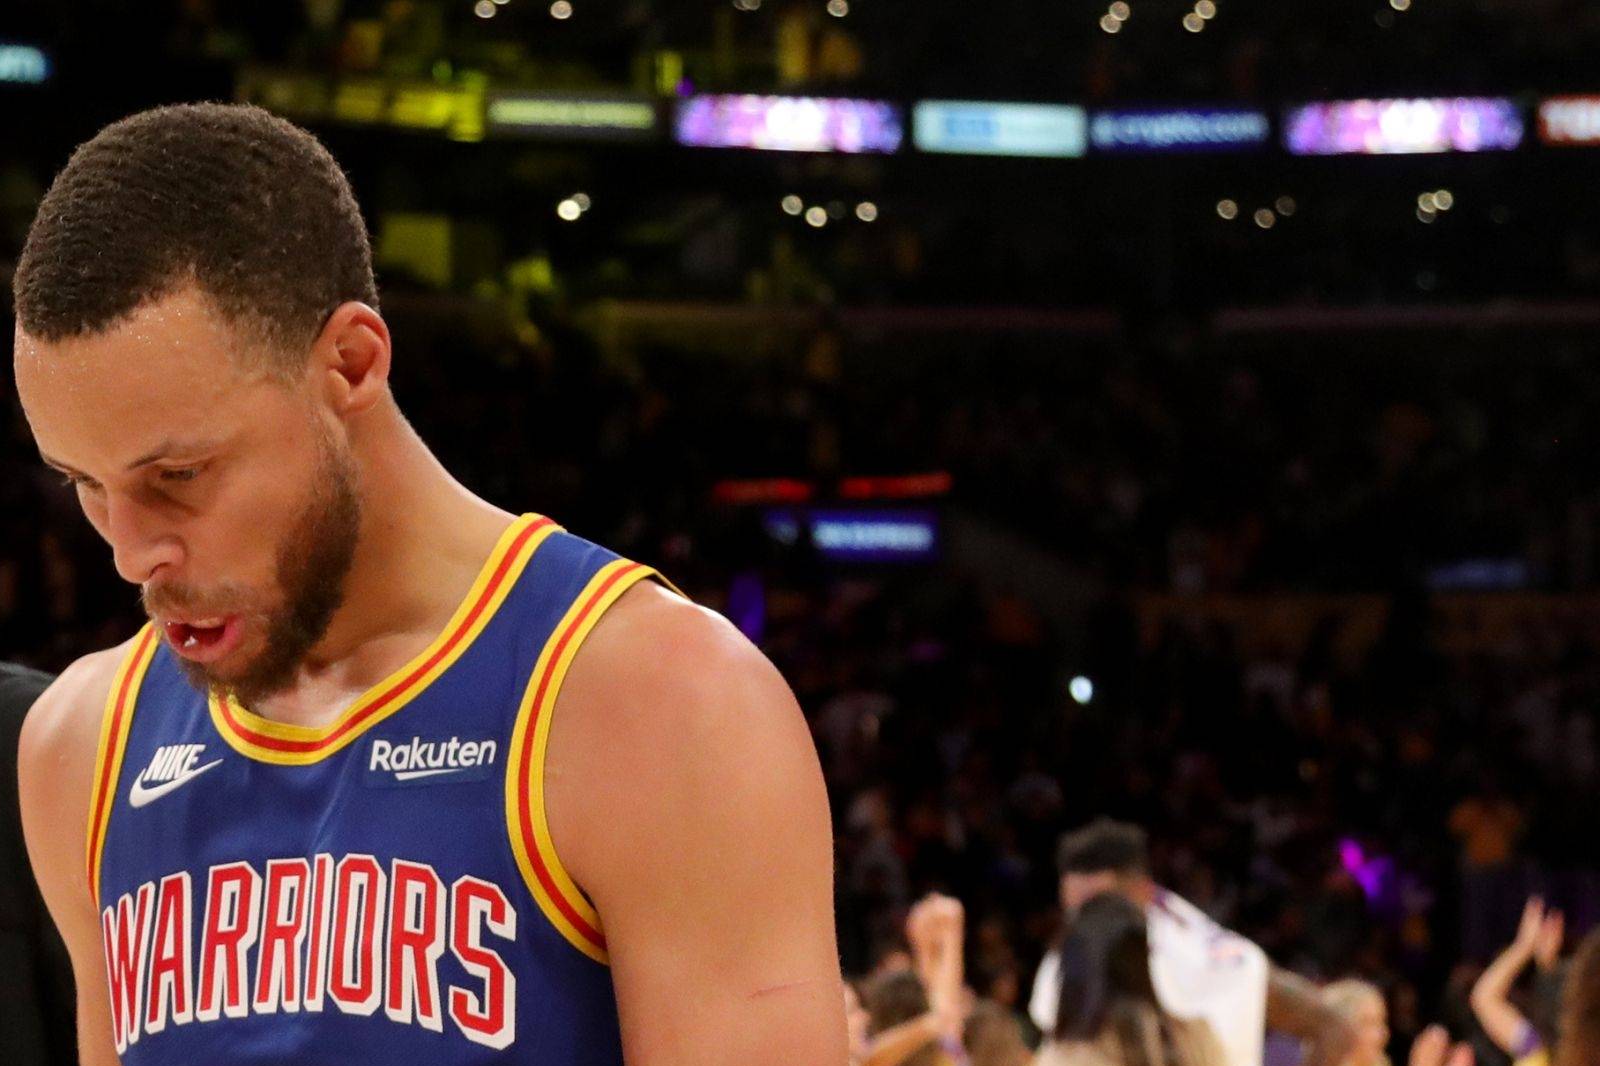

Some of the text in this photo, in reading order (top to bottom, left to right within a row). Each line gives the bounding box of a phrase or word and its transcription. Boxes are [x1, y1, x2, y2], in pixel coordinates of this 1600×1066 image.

[142, 744, 206, 782] NIKE
[369, 736, 496, 772] Rakuten
[102, 852, 516, 1055] WARRIORS
